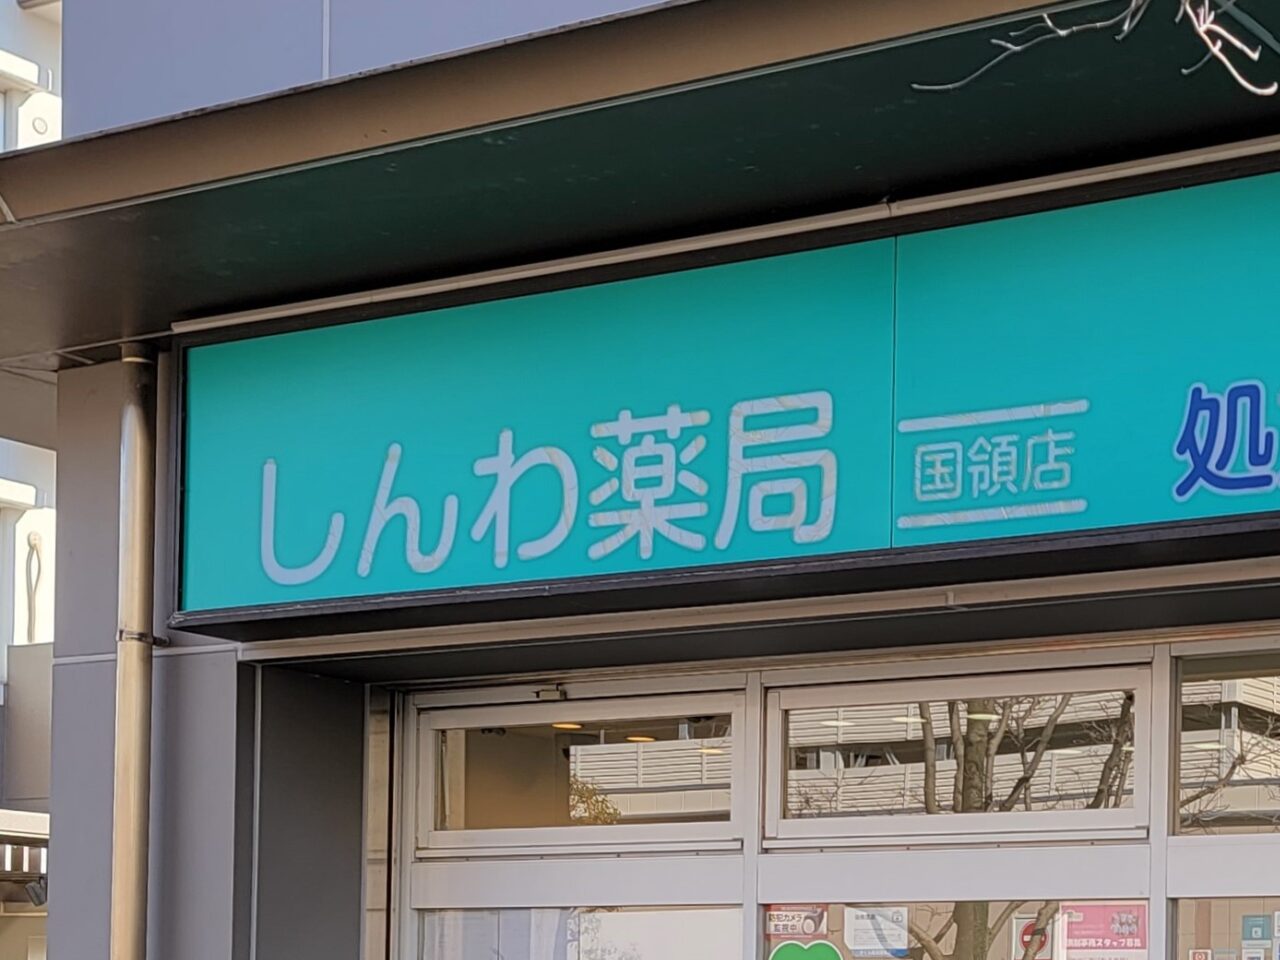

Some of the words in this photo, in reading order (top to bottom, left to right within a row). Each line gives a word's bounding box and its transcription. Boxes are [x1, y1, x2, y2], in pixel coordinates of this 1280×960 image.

[260, 390, 839, 586] しんわ薬局
[913, 428, 1077, 503] 国領店
